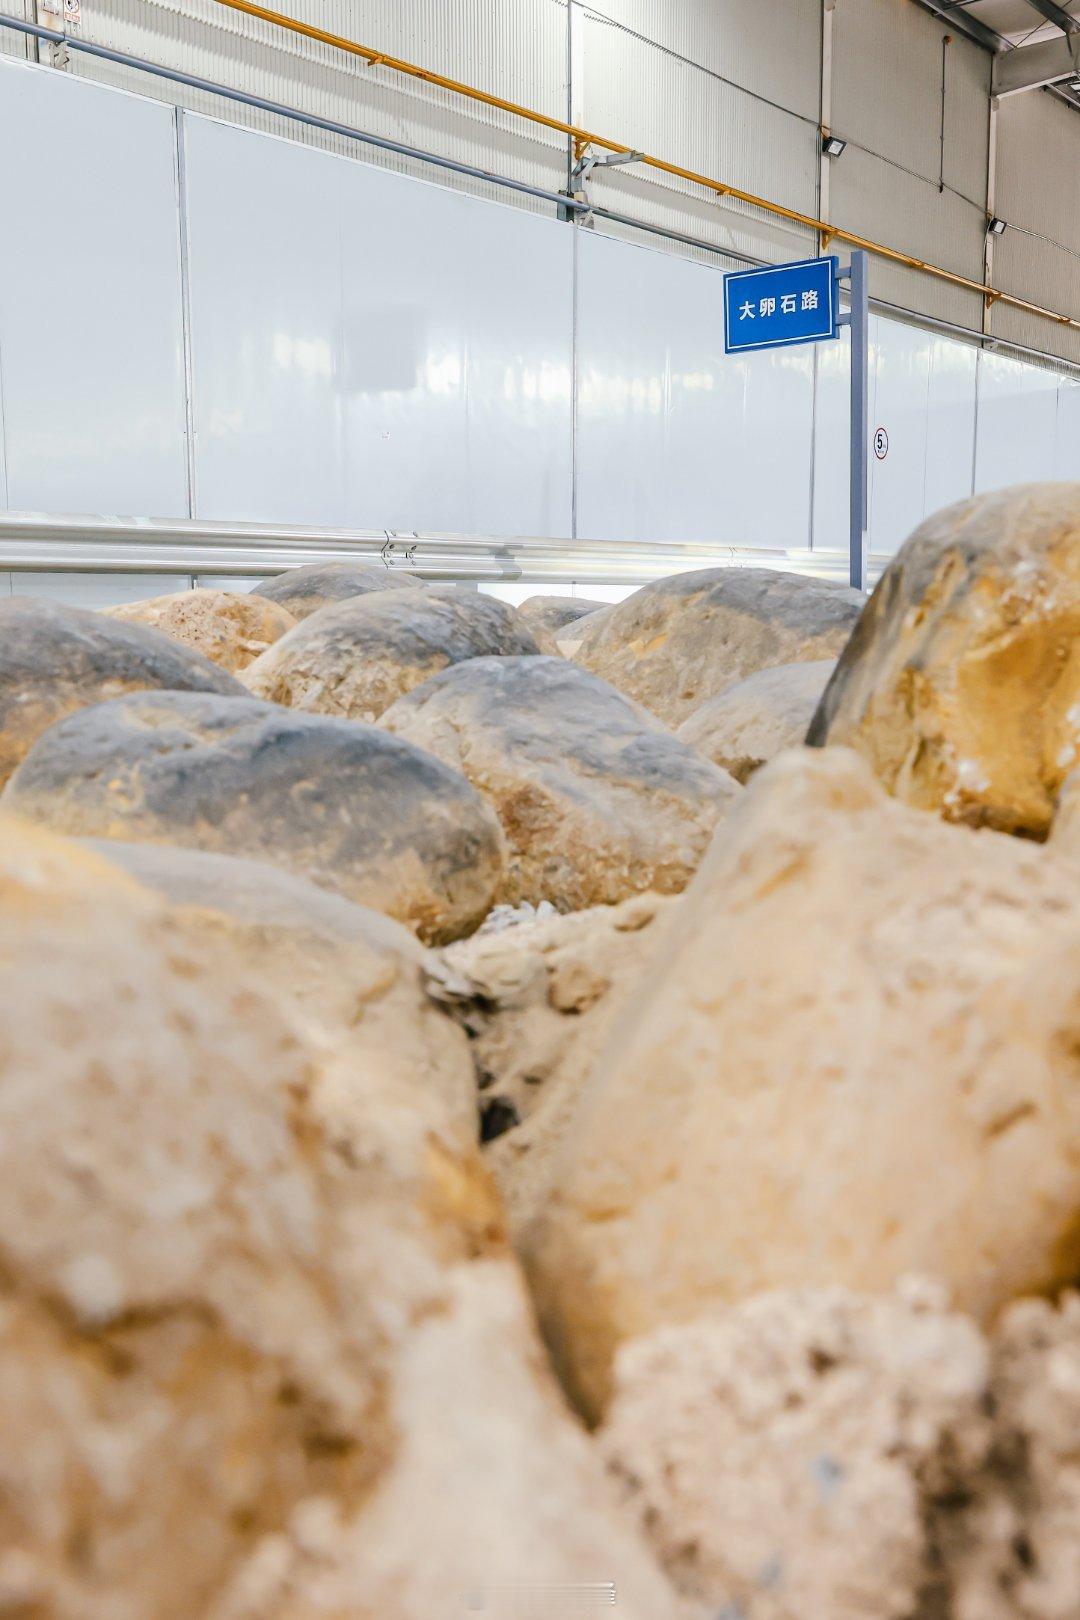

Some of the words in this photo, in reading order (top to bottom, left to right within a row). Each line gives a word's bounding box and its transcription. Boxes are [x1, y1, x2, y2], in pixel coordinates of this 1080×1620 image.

[739, 290, 818, 321] 大卵石路
[877, 433, 883, 449] 5
